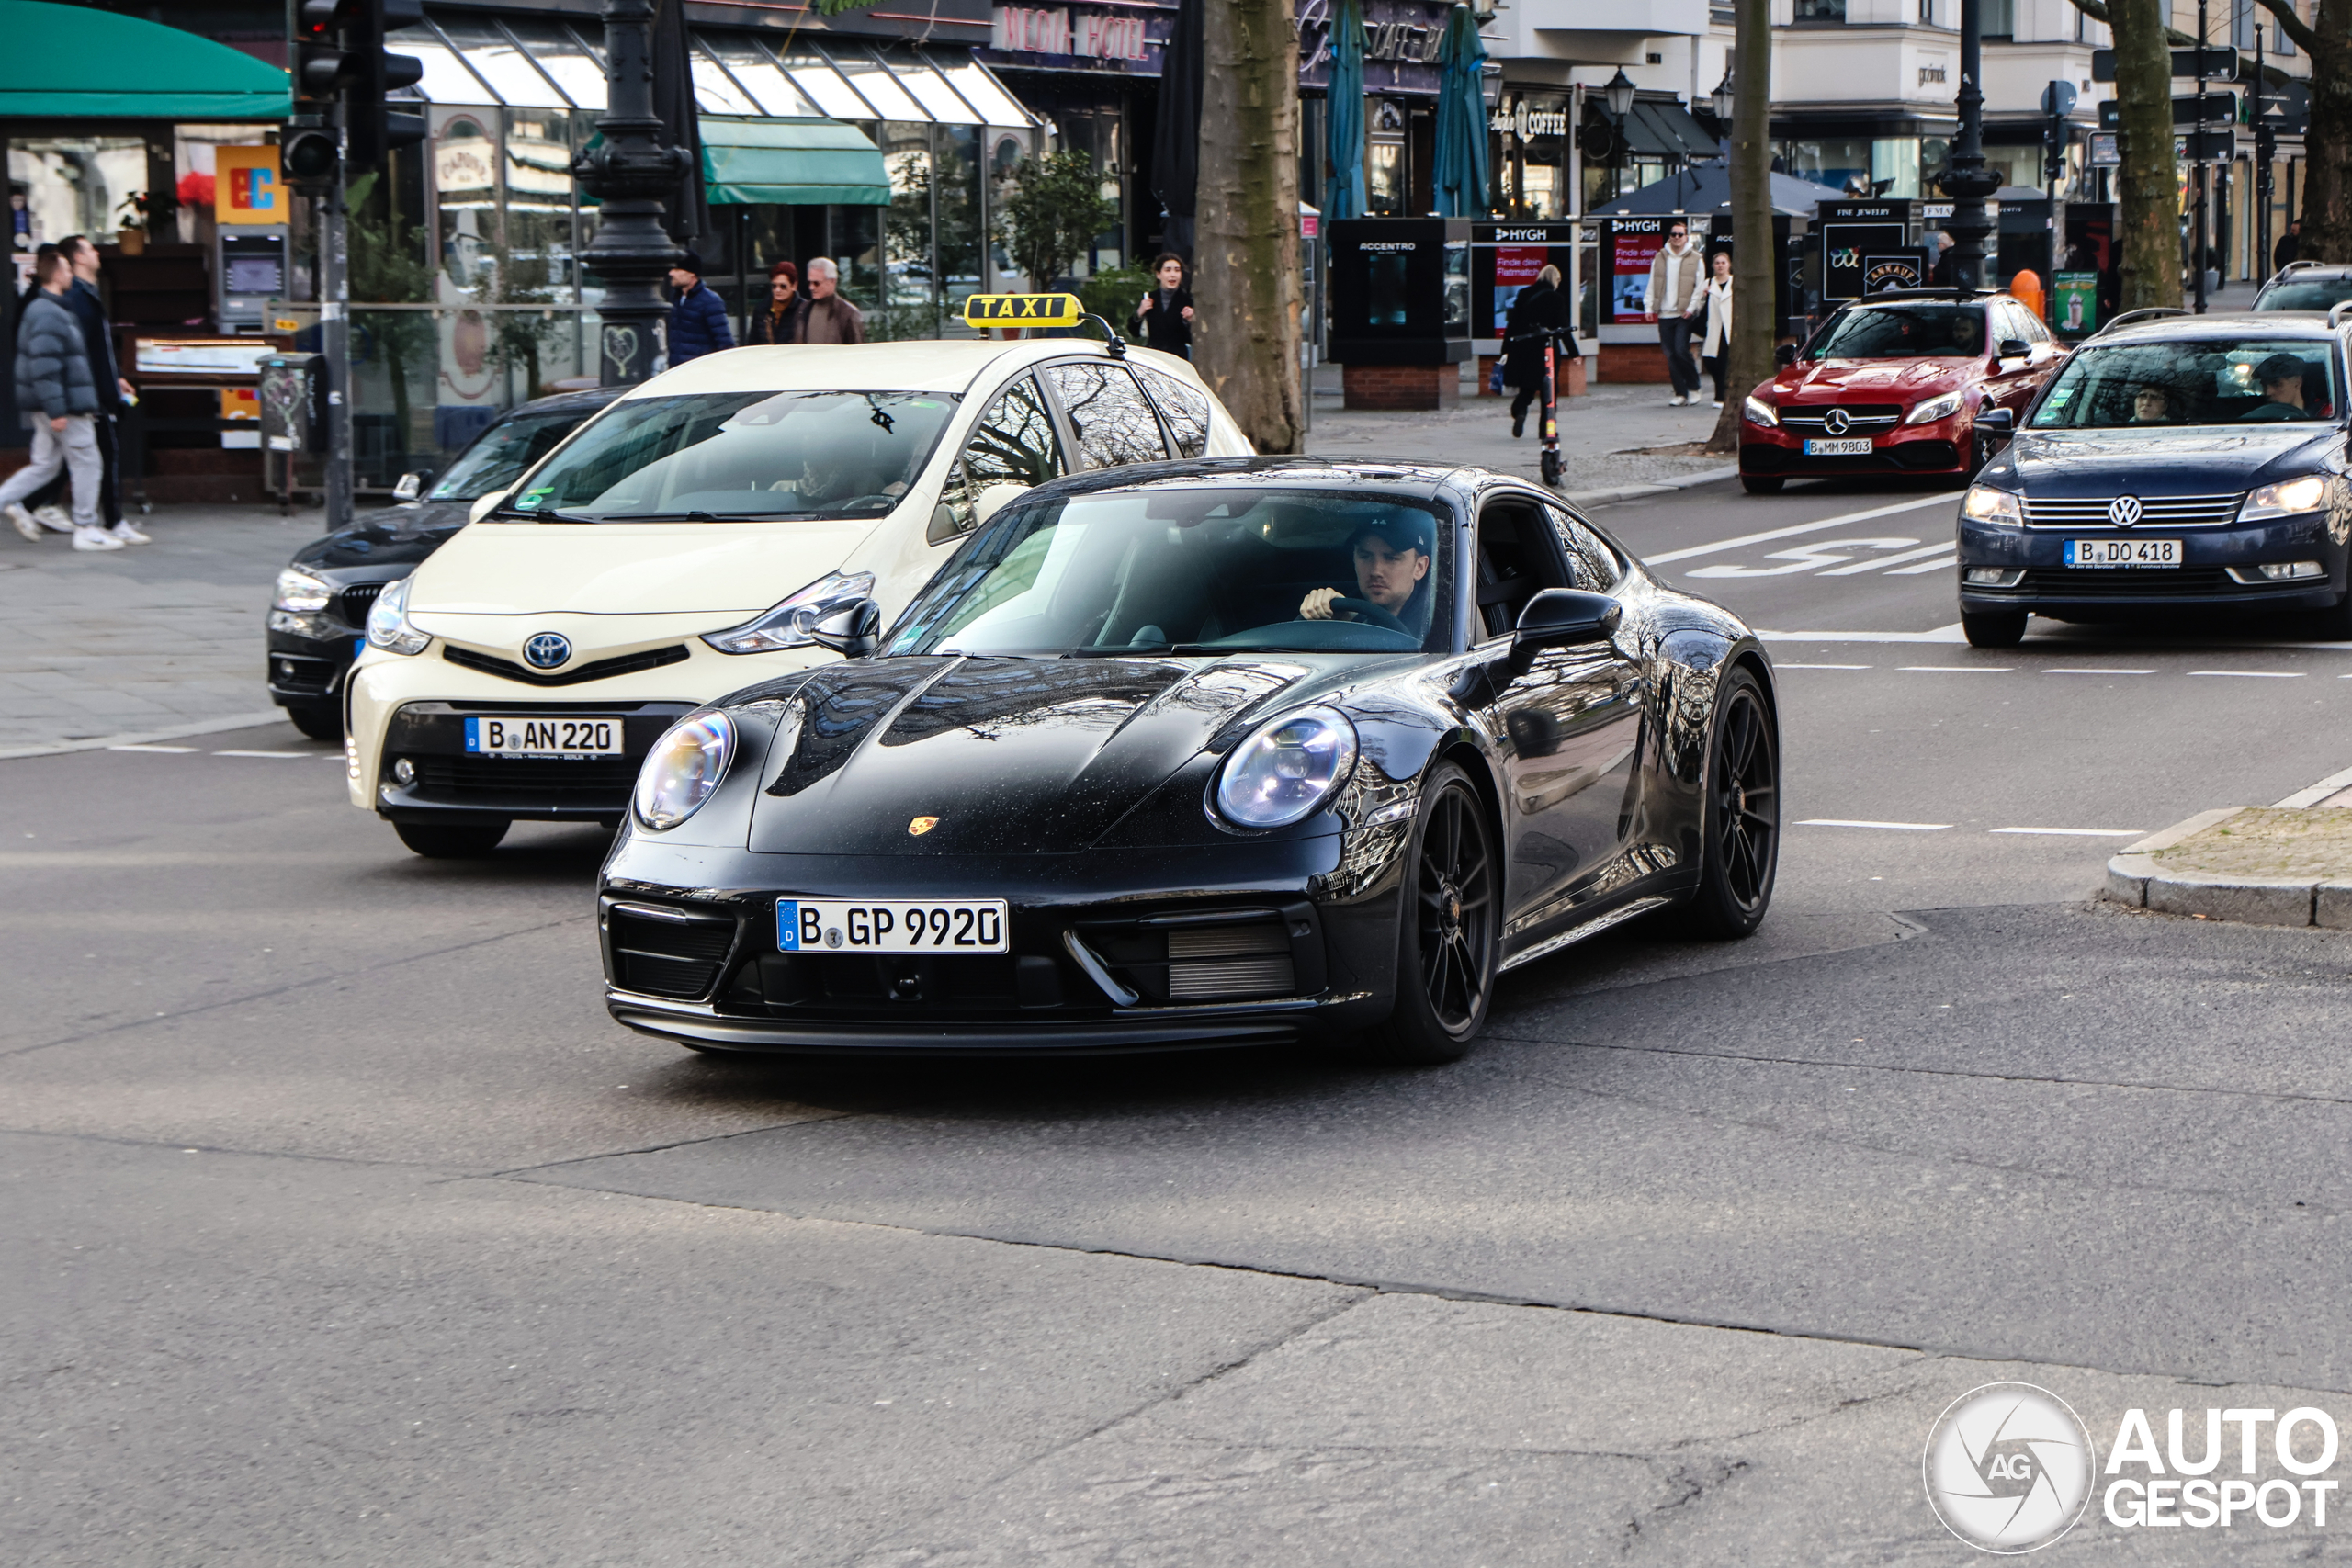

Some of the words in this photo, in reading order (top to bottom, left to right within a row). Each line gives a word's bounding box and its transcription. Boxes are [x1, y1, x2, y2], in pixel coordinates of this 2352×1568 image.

[1002, 6, 1072, 55] MEDIA
[1087, 16, 1149, 61] HOTEL
[1528, 111, 1566, 135] COFFEE
[1624, 220, 1660, 231] HYGH
[1510, 229, 1547, 240] HYGH
[1616, 248, 1637, 256] Finde
[1639, 248, 1658, 256] dein
[1497, 258, 1521, 266] Finde
[1521, 258, 1543, 266] dein
[1871, 264, 1915, 280] ANKAUF
[980, 298, 1054, 317] TAXI
[1810, 442, 1818, 453] B
[1825, 442, 1839, 453] MM
[1841, 441, 1870, 453] 9803
[2081, 543, 2094, 561] B
[2107, 543, 2132, 561] DO
[2137, 542, 2174, 561] 418
[469, 738, 476, 746] D
[489, 721, 505, 749] B
[523, 722, 557, 749] AN
[561, 723, 611, 750] 220
[785, 930, 794, 942] D
[799, 908, 822, 944] B
[847, 908, 895, 946] GP
[905, 908, 1001, 946] 9920
